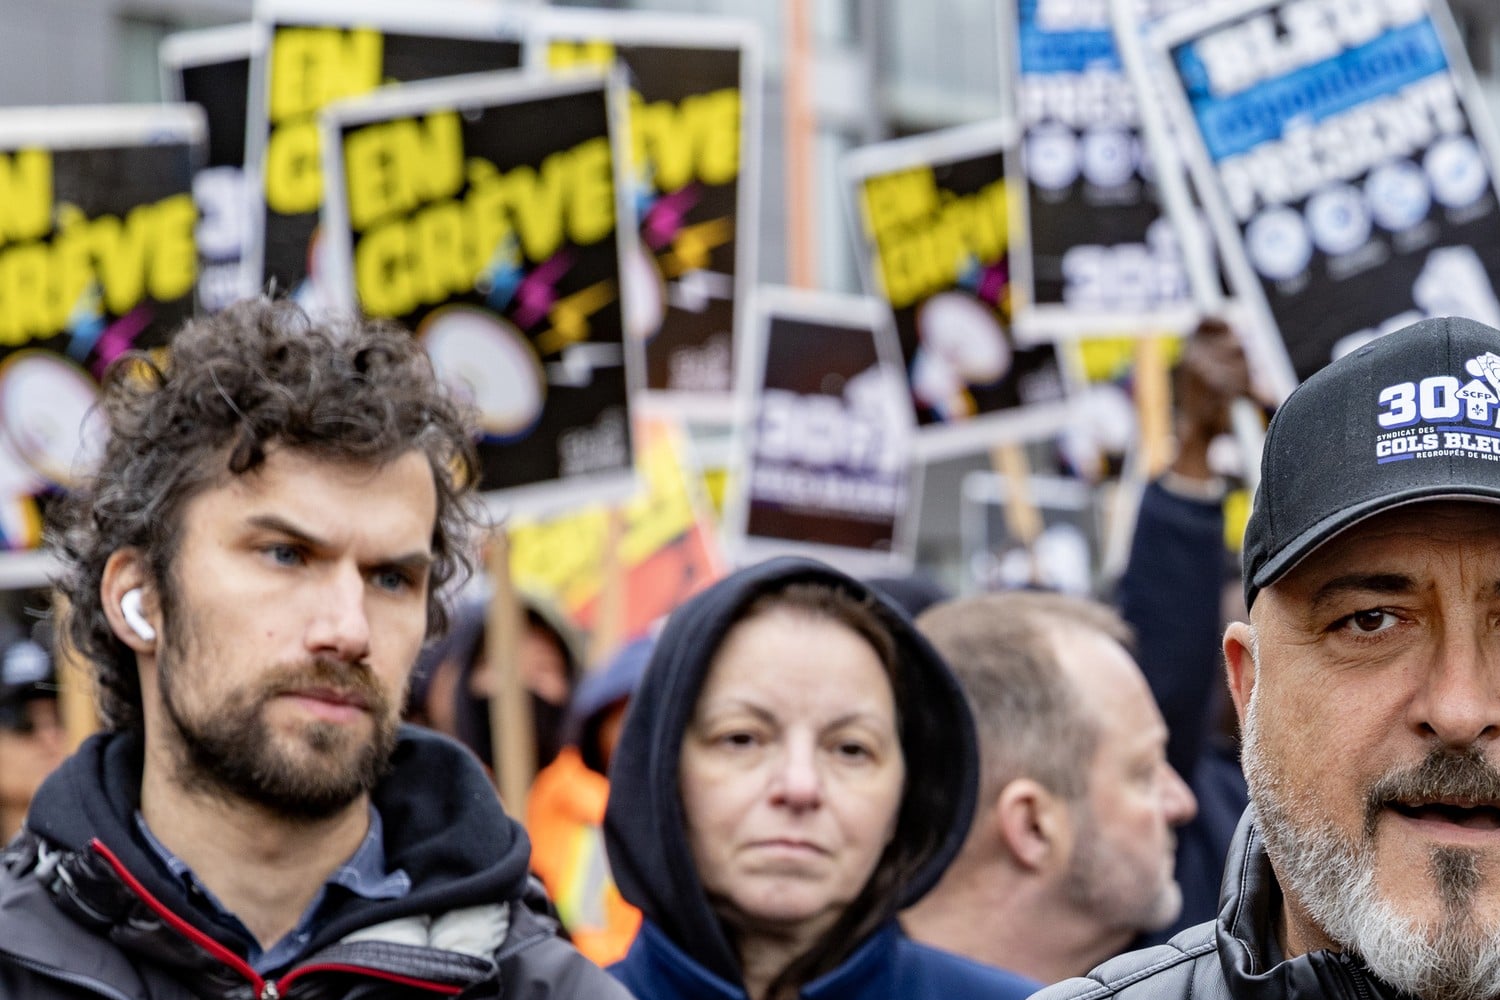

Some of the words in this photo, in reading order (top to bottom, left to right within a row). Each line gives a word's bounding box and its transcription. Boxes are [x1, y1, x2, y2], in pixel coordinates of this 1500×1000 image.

[268, 26, 384, 122] EN
[343, 108, 465, 230] EN
[355, 134, 618, 320] GRÈVE
[1462, 389, 1493, 401] SCFP
[1376, 427, 1416, 442] SYNDICAT
[1418, 426, 1435, 435] DES
[1376, 433, 1439, 458] COLS
[1416, 448, 1465, 459] REGROUPÉS
[1467, 450, 1479, 459] DE
